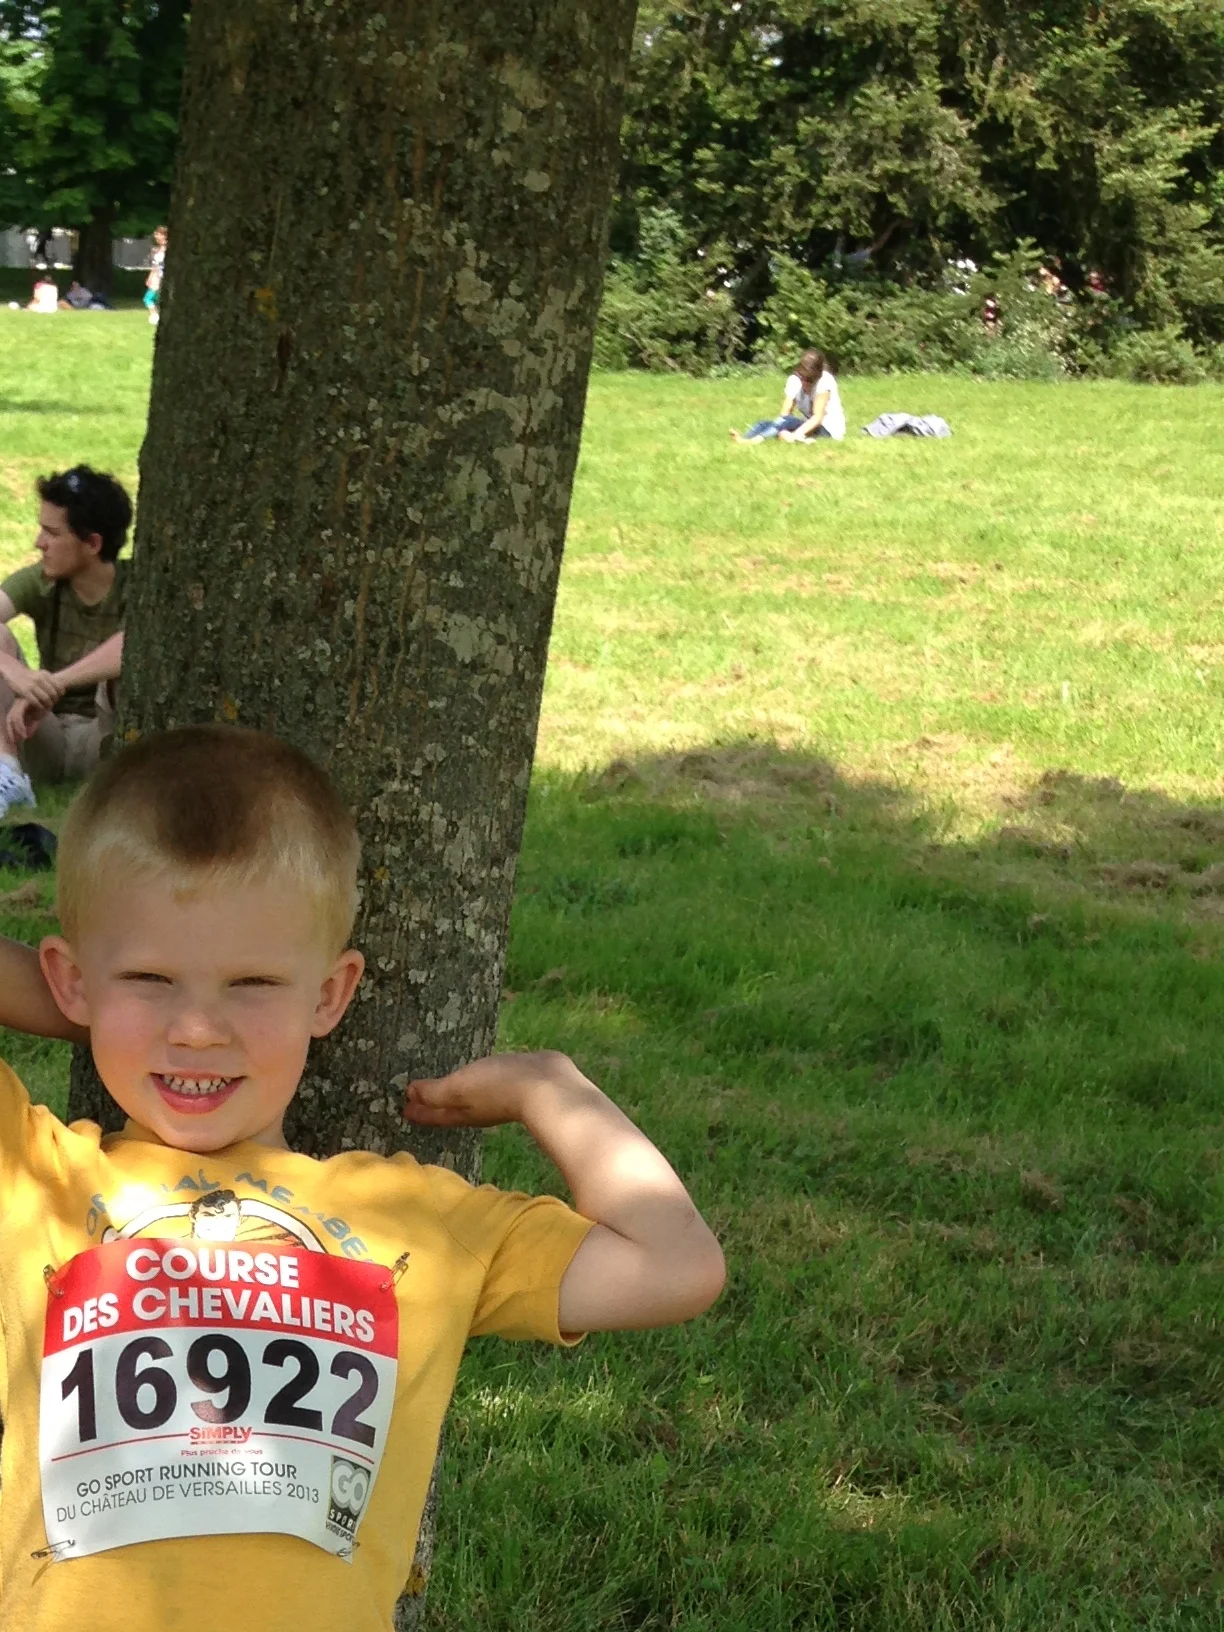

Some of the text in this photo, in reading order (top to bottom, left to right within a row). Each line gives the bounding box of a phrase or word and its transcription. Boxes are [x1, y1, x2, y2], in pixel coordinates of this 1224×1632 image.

[125, 1247, 300, 1289] COURSE
[62, 1287, 376, 1343] DES CHEVALIERS
[60, 1333, 380, 1449] 16922
[56, 1480, 320, 1522] DU CHÂTEAU DE VERSAILLES 2013
[76, 1461, 297, 1498] GO SPORT RUNNING TOUR
[332, 1461, 369, 1515] GO
